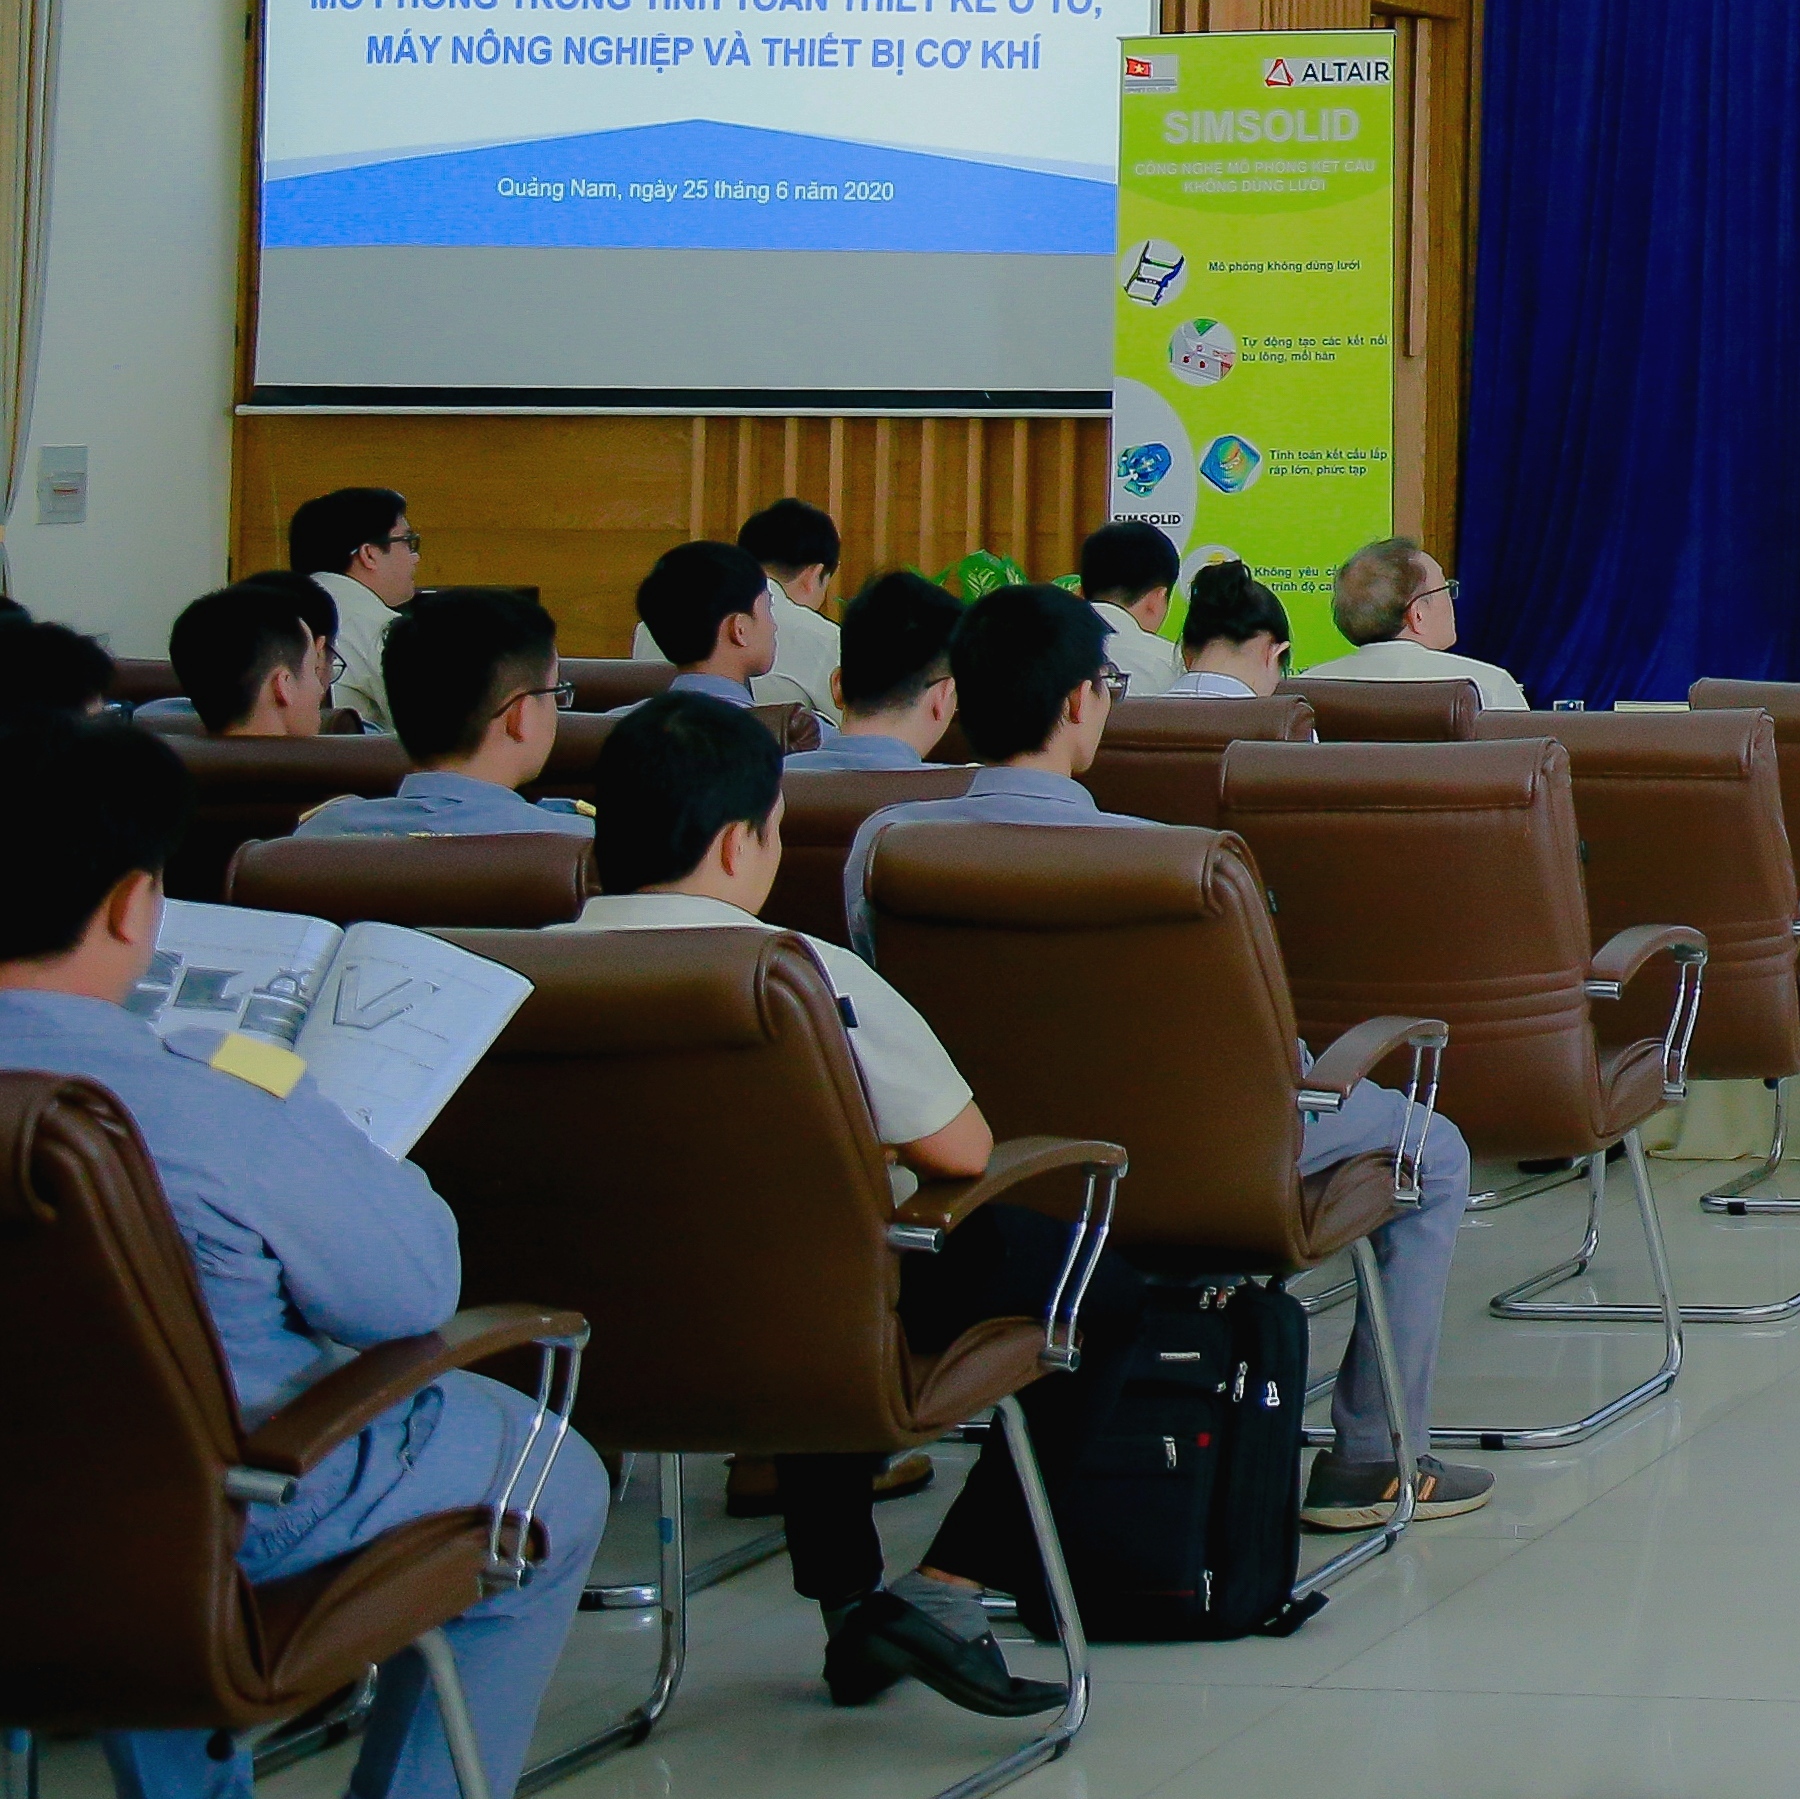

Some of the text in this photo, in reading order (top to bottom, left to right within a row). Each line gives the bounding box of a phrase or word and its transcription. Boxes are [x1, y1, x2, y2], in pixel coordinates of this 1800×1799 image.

[366, 30, 1041, 75] MÁY NÔNG NGHIỆP VÀ THIẾT BỊ CƠ KHÍ
[1302, 61, 1390, 82] ALTAIR
[1163, 108, 1359, 144] SIMSOLID
[498, 175, 894, 205] Quảng Nam, ngày 25 tháng 6 năm 2020
